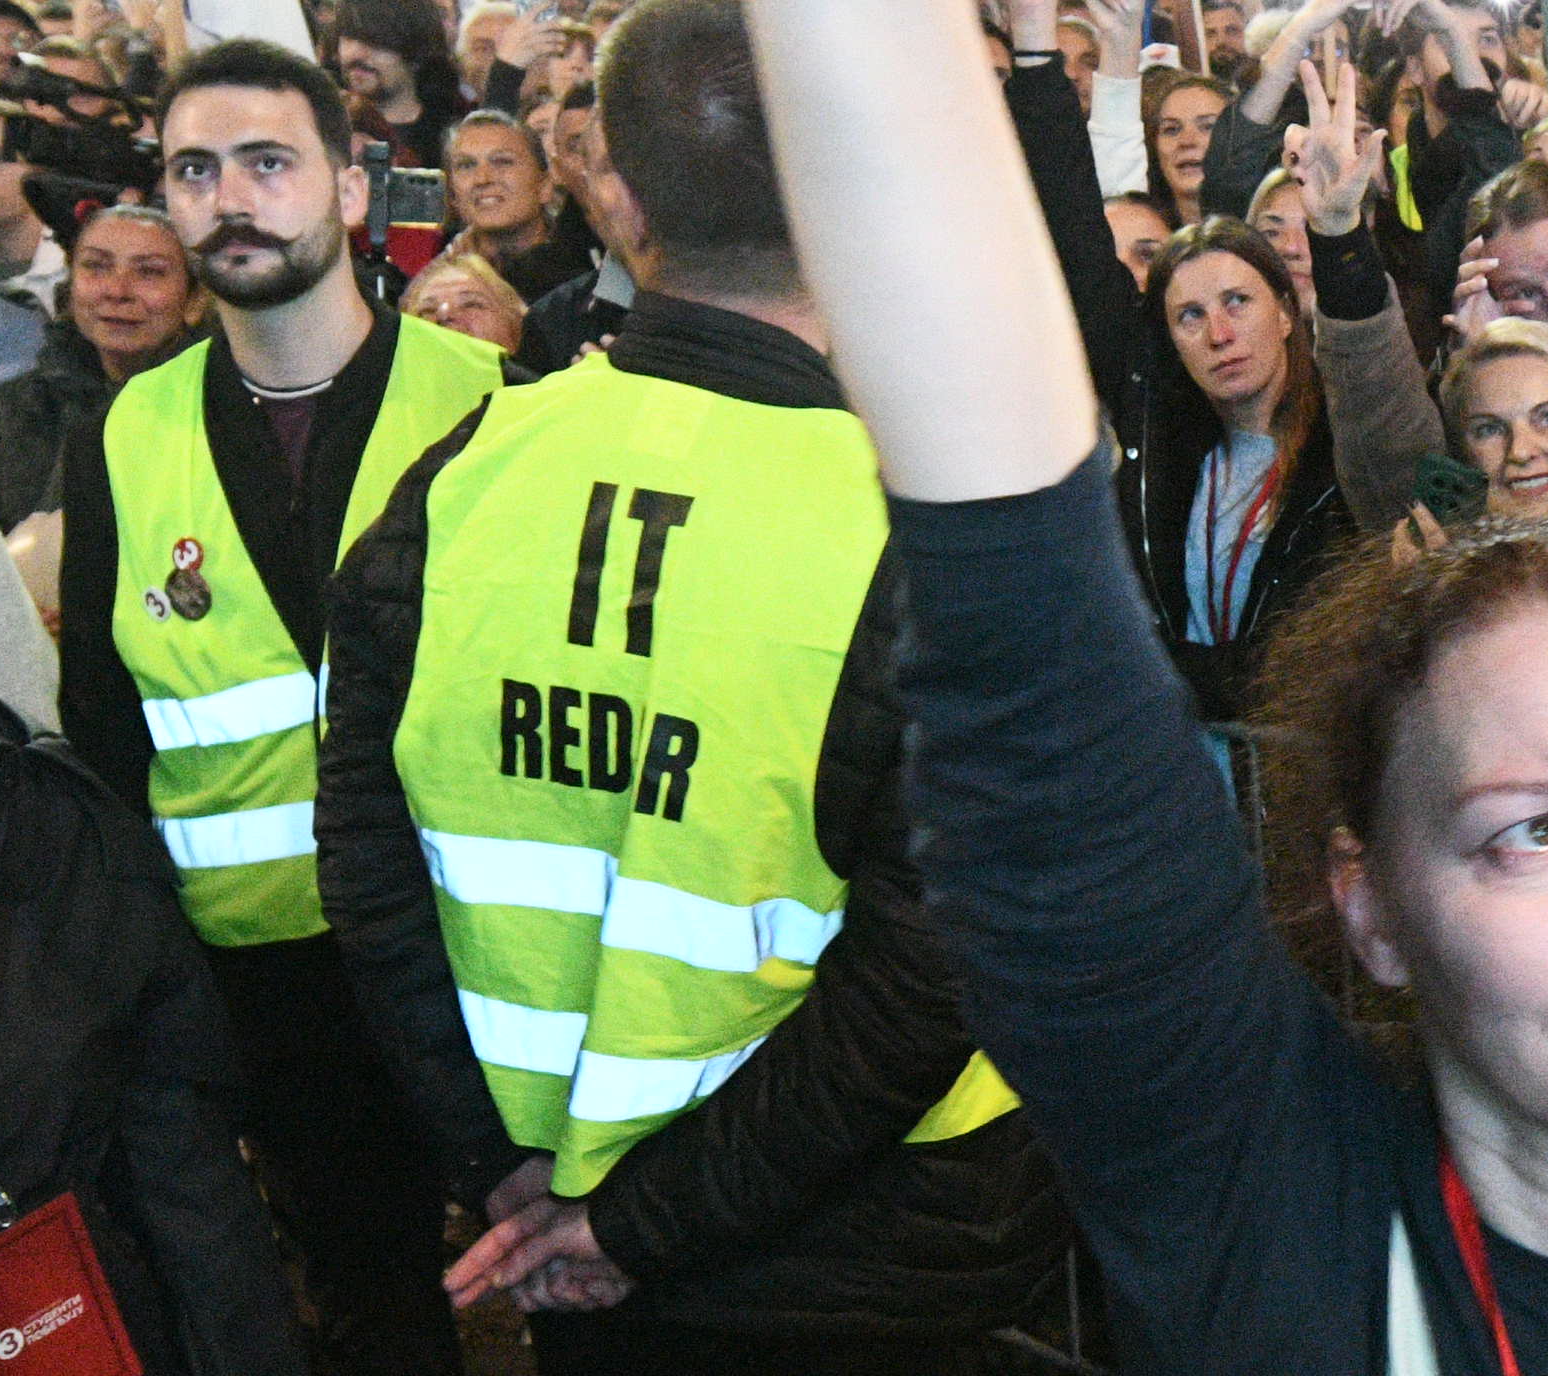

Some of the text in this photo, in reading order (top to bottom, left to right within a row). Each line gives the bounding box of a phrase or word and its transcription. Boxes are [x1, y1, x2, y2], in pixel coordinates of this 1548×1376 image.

[567, 481, 695, 657] IT
[145, 593, 165, 617] 3
[0, 1332, 18, 1355] 3
